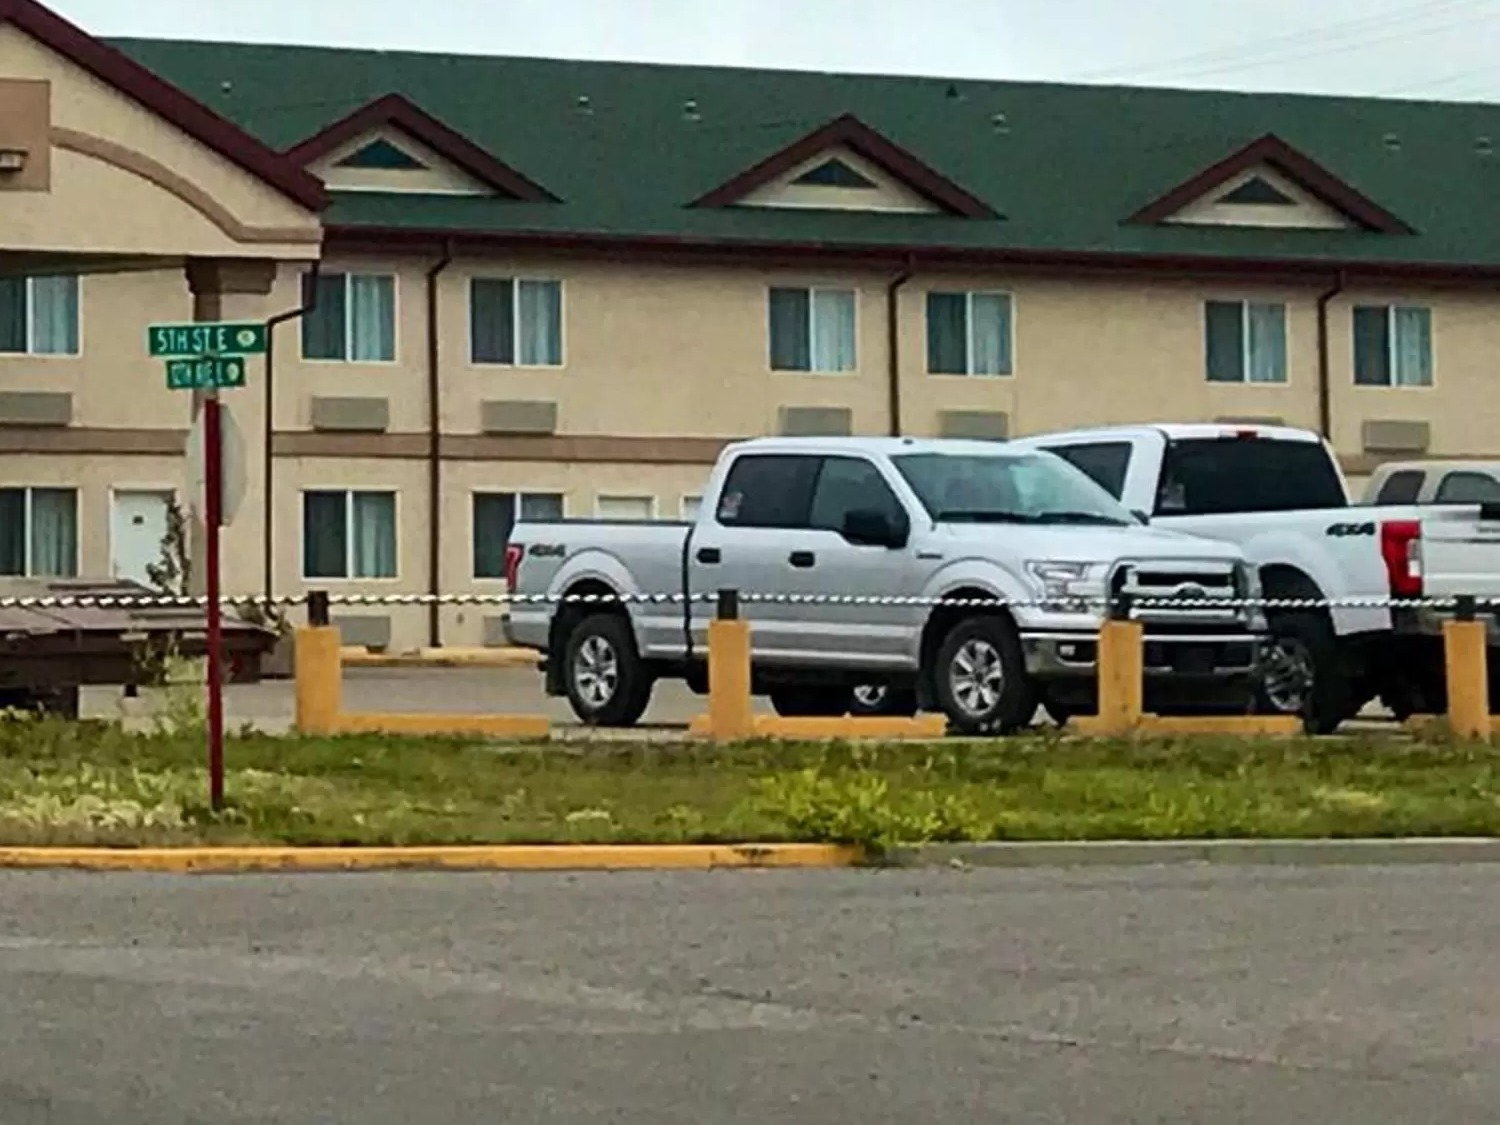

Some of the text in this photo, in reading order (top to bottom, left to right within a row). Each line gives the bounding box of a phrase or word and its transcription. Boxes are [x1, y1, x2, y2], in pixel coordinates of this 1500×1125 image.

[157, 328, 228, 352] 5TH ST E
